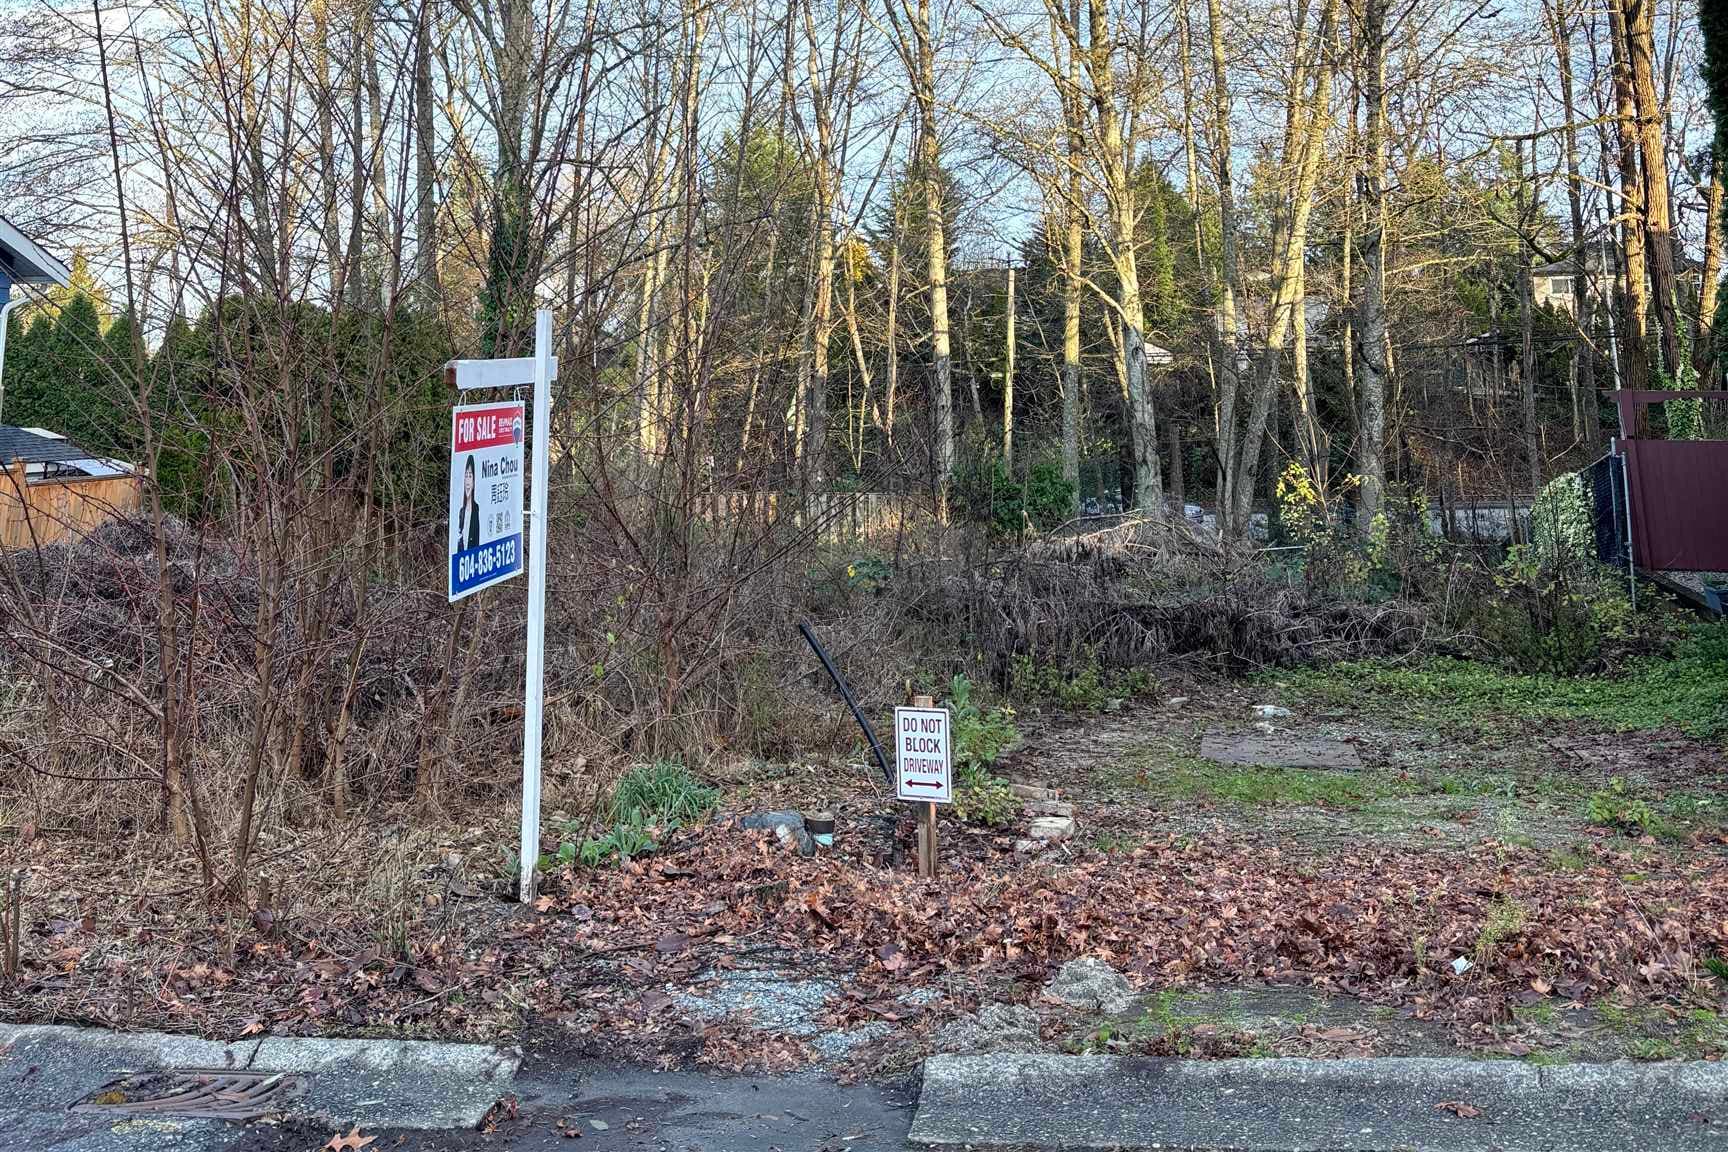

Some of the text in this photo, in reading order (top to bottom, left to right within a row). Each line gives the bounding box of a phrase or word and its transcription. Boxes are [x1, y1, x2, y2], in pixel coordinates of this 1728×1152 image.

[458, 415, 496, 444] FOR SALE
[481, 456, 518, 479] Nina Chou
[459, 539, 515, 583] 604-836-5123
[903, 717, 942, 734] DO NOT
[905, 737, 941, 754] BLOCK
[903, 757, 944, 775] DRIVEWAY
